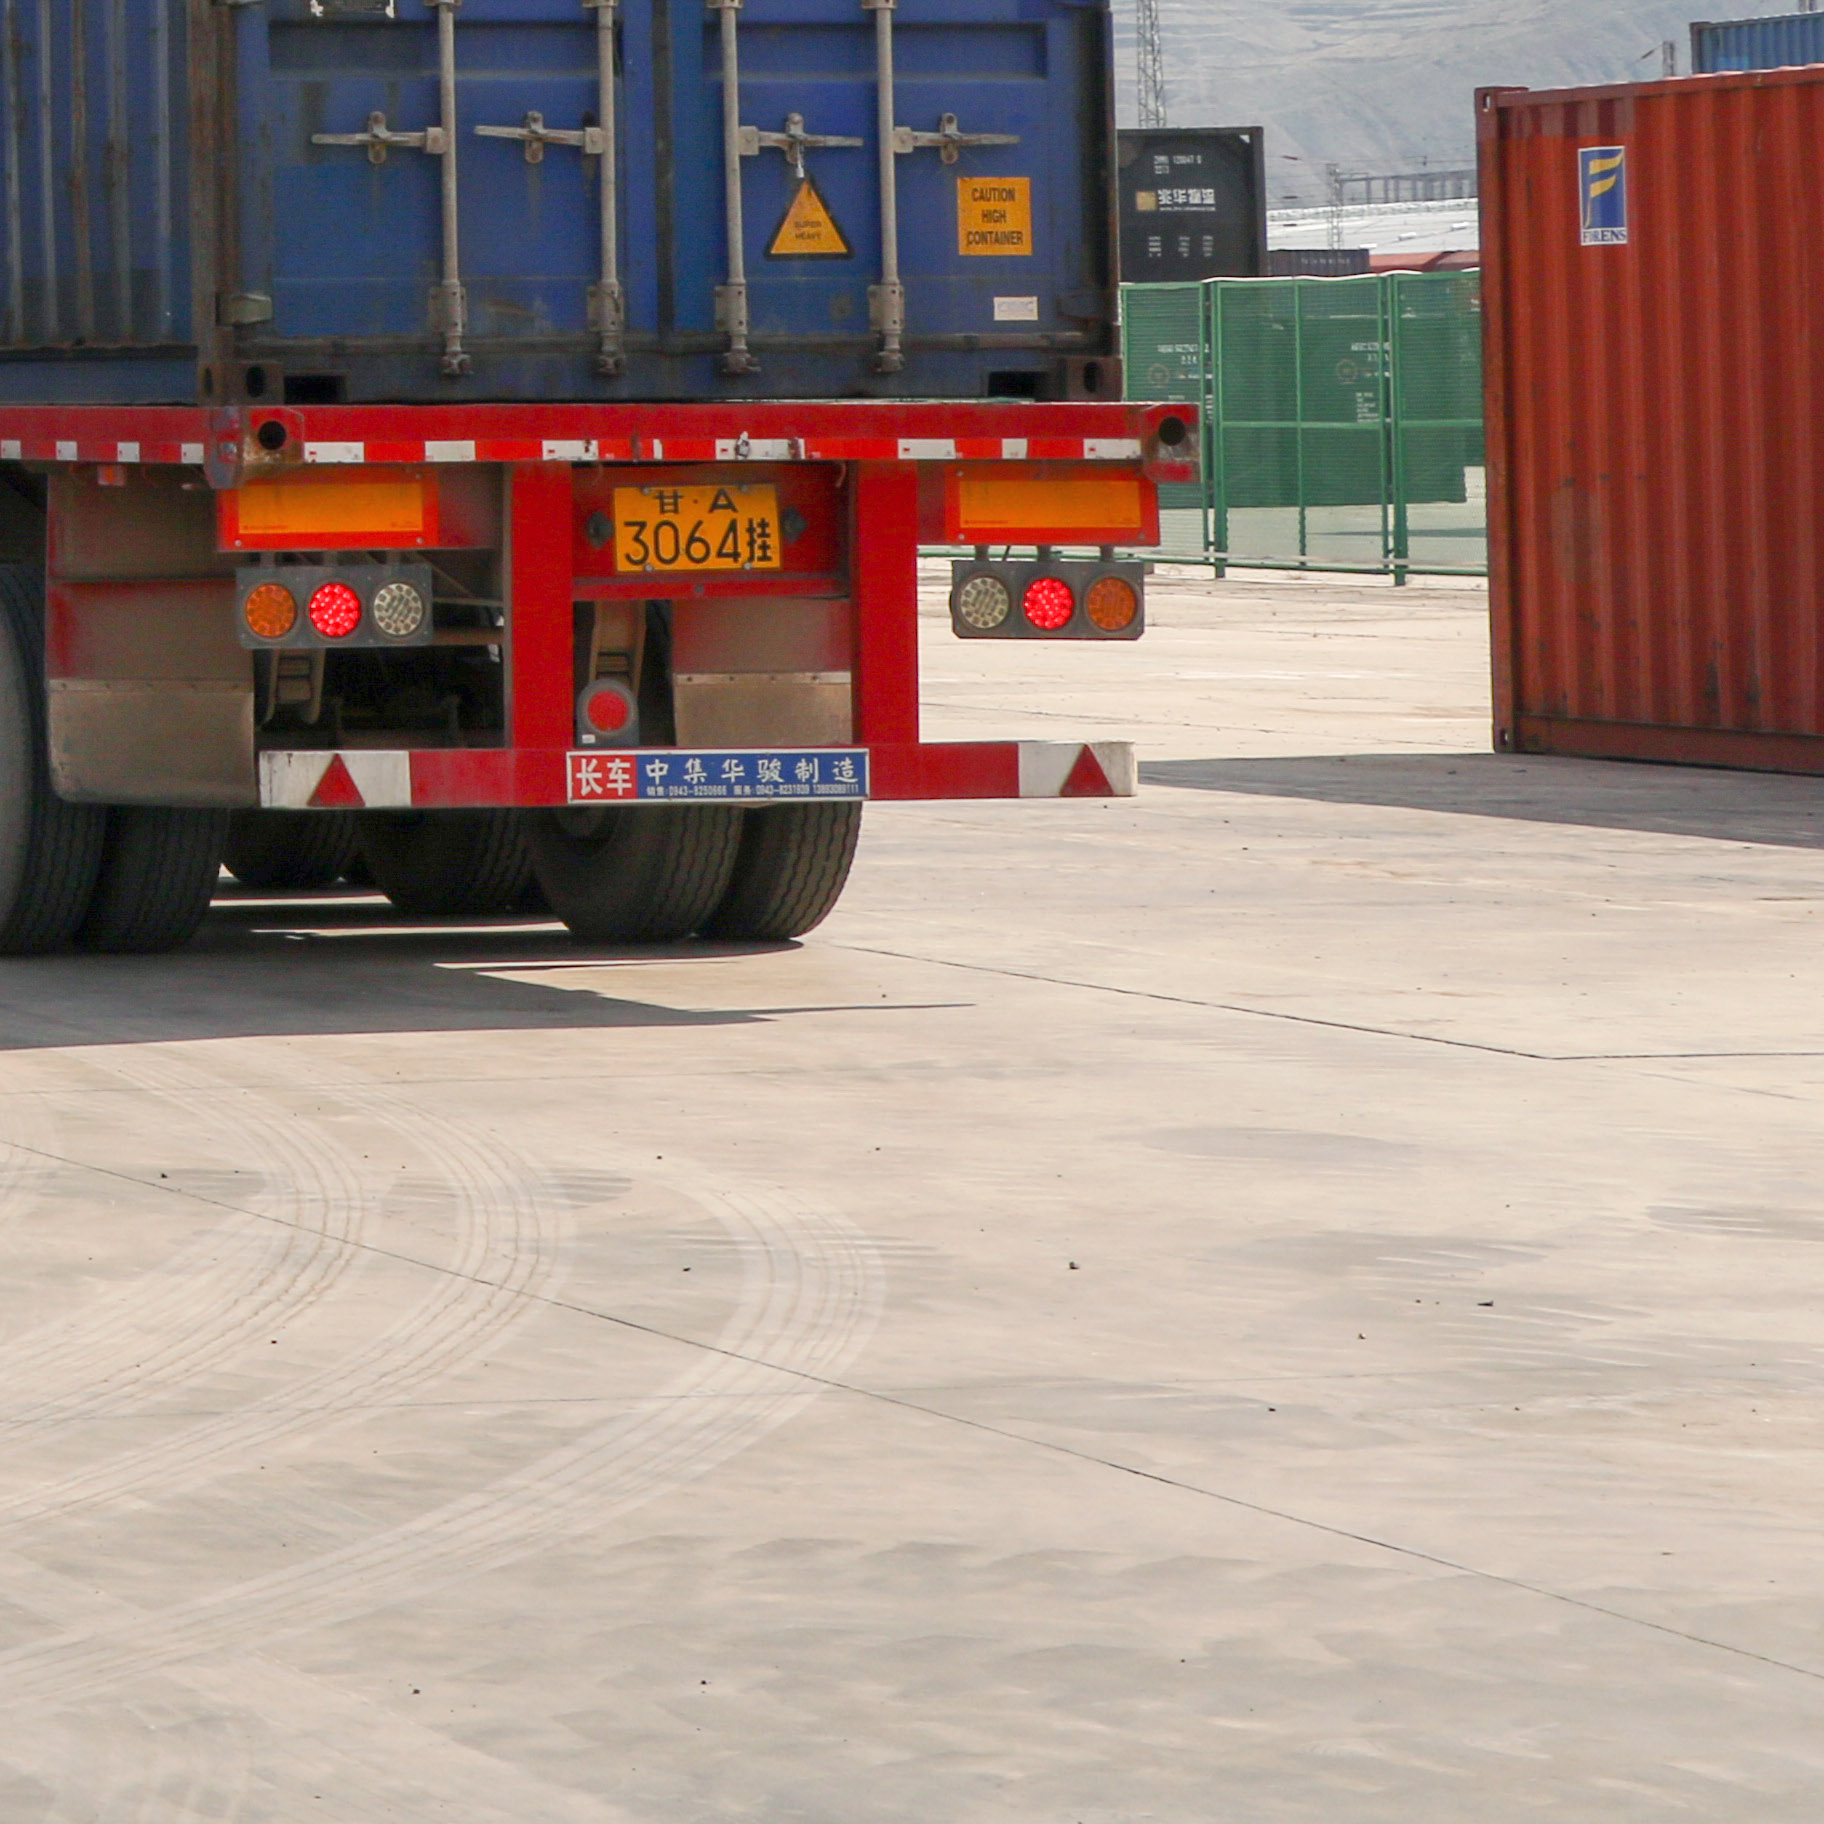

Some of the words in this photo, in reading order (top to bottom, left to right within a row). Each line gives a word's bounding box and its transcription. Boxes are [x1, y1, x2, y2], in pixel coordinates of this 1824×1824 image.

[971, 187, 1016, 202] CAUTION
[981, 209, 1007, 223] HIGH
[966, 230, 1024, 246] CONTAINER
[576, 758, 632, 795] 长车
